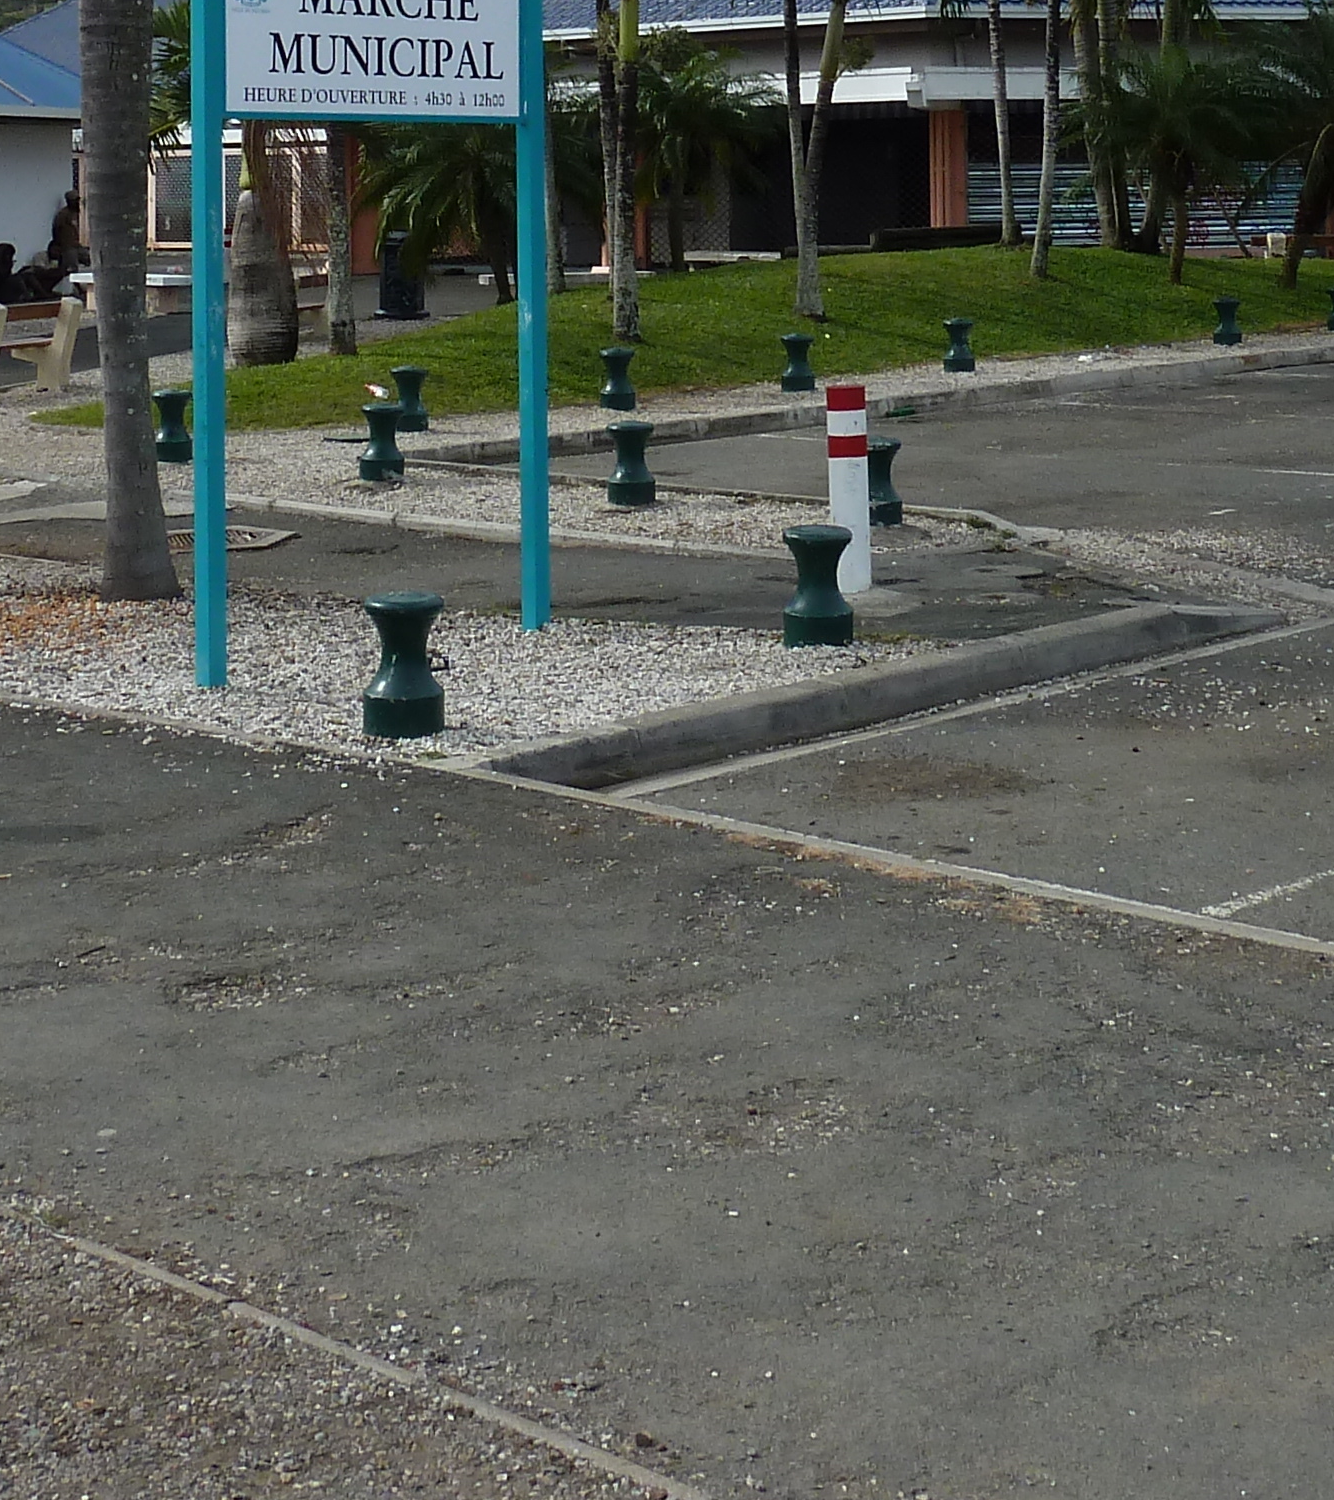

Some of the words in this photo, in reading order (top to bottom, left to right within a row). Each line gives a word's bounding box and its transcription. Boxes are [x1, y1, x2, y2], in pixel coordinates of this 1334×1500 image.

[269, 31, 504, 80] MUNICIPAL
[244, 87, 297, 103] HEURE
[301, 88, 407, 105] D'OUVERTURE
[425, 91, 452, 106] 4h30
[459, 91, 466, 106] à
[473, 92, 505, 107] 12h00
